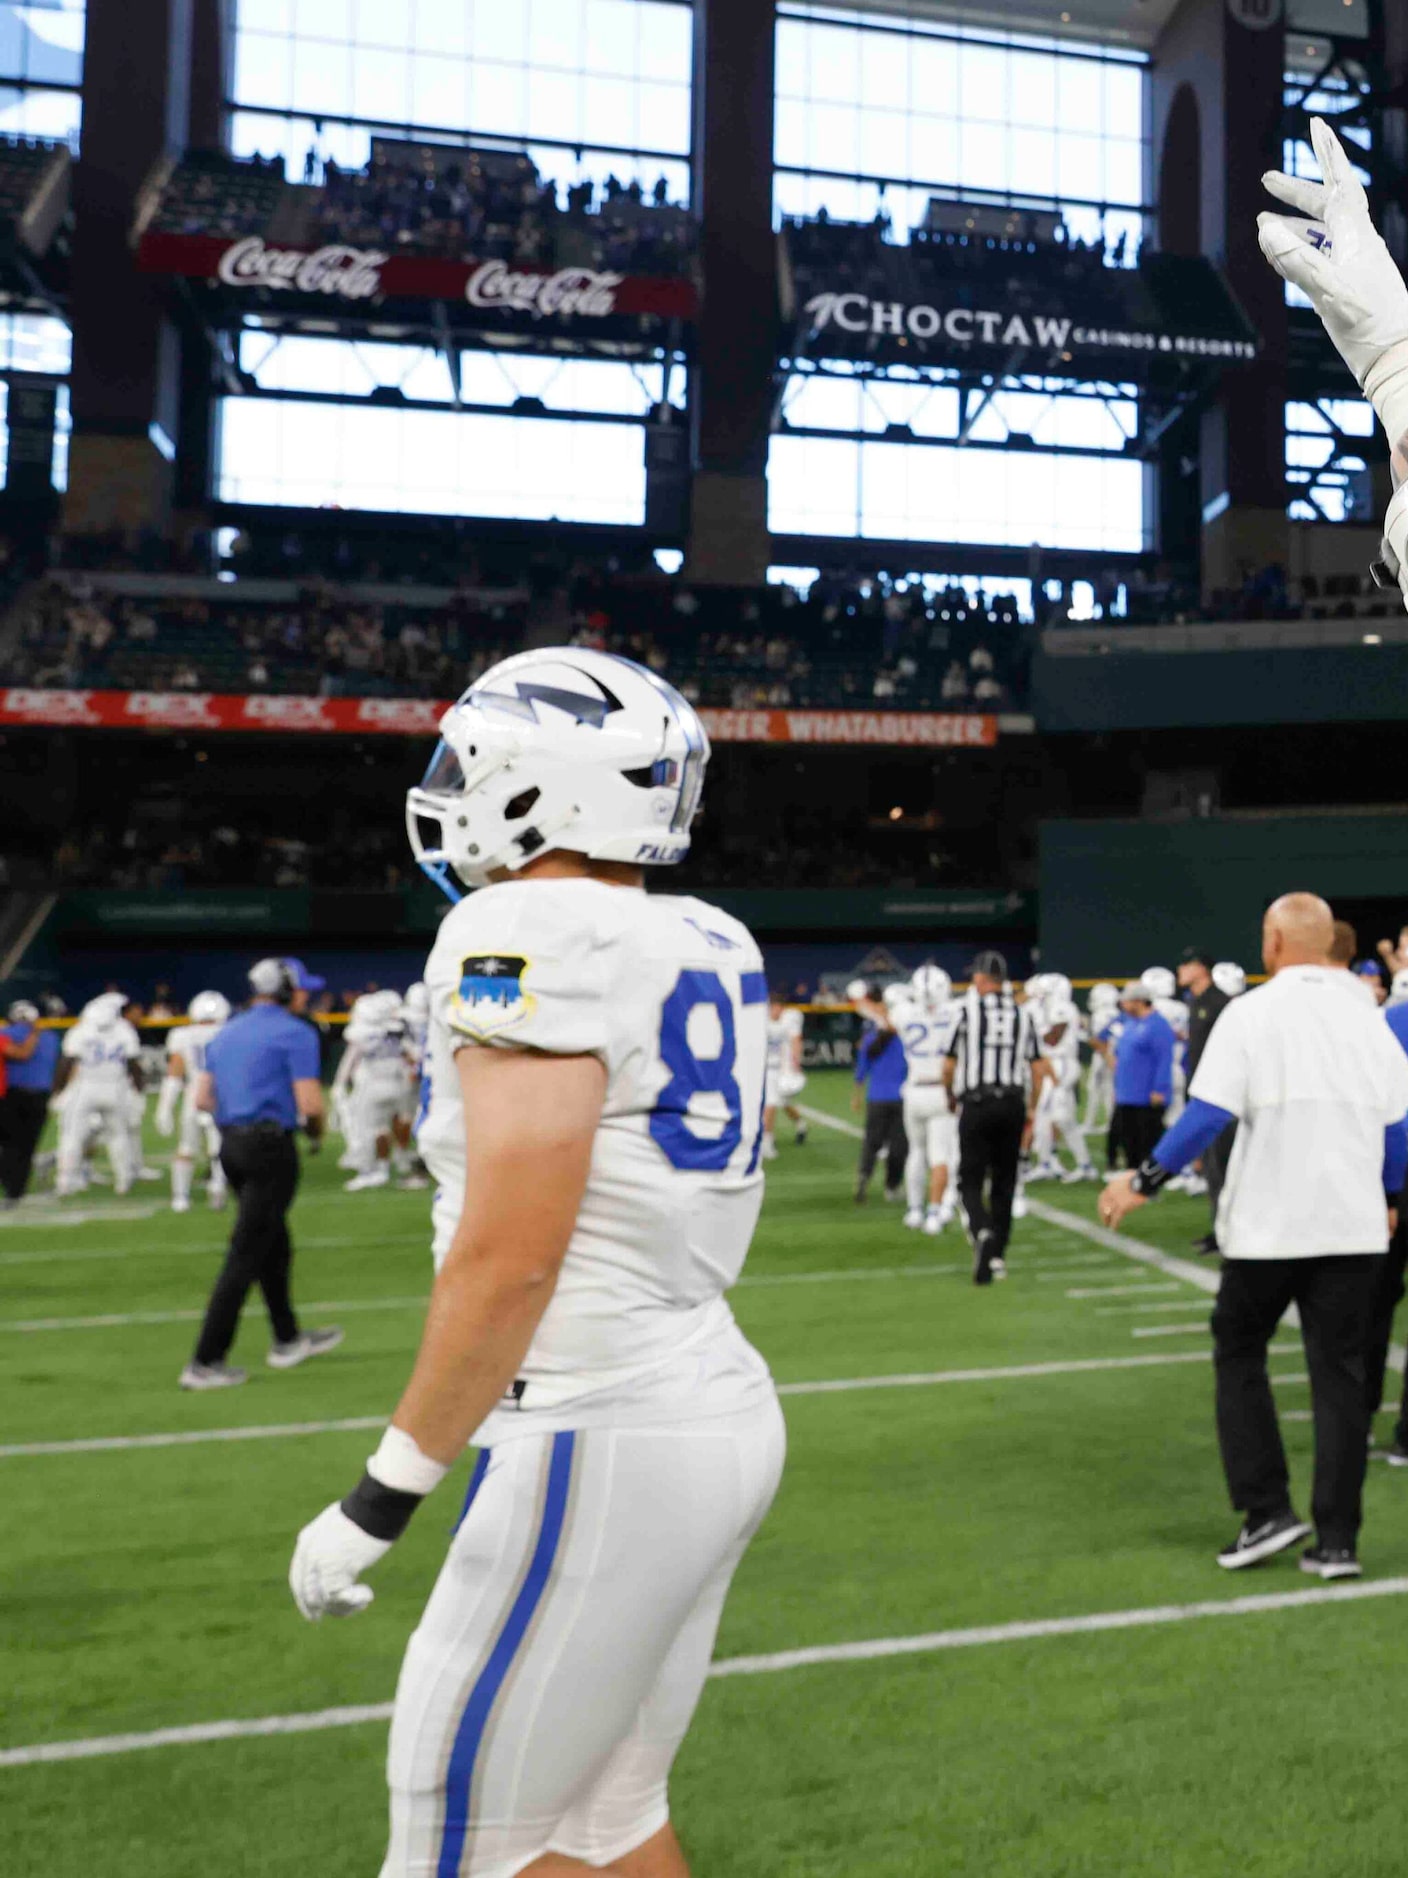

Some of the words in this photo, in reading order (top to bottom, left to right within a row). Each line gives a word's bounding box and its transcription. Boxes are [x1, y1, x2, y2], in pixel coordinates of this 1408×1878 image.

[832, 293, 1072, 347] CHOCTAW
[1073, 326, 1156, 351] CASINOS
[1158, 334, 1172, 352] &
[1174, 335, 1256, 360] RESORTS
[786, 713, 985, 743] WHATABURGER
[984, 1014, 1014, 1047] H
